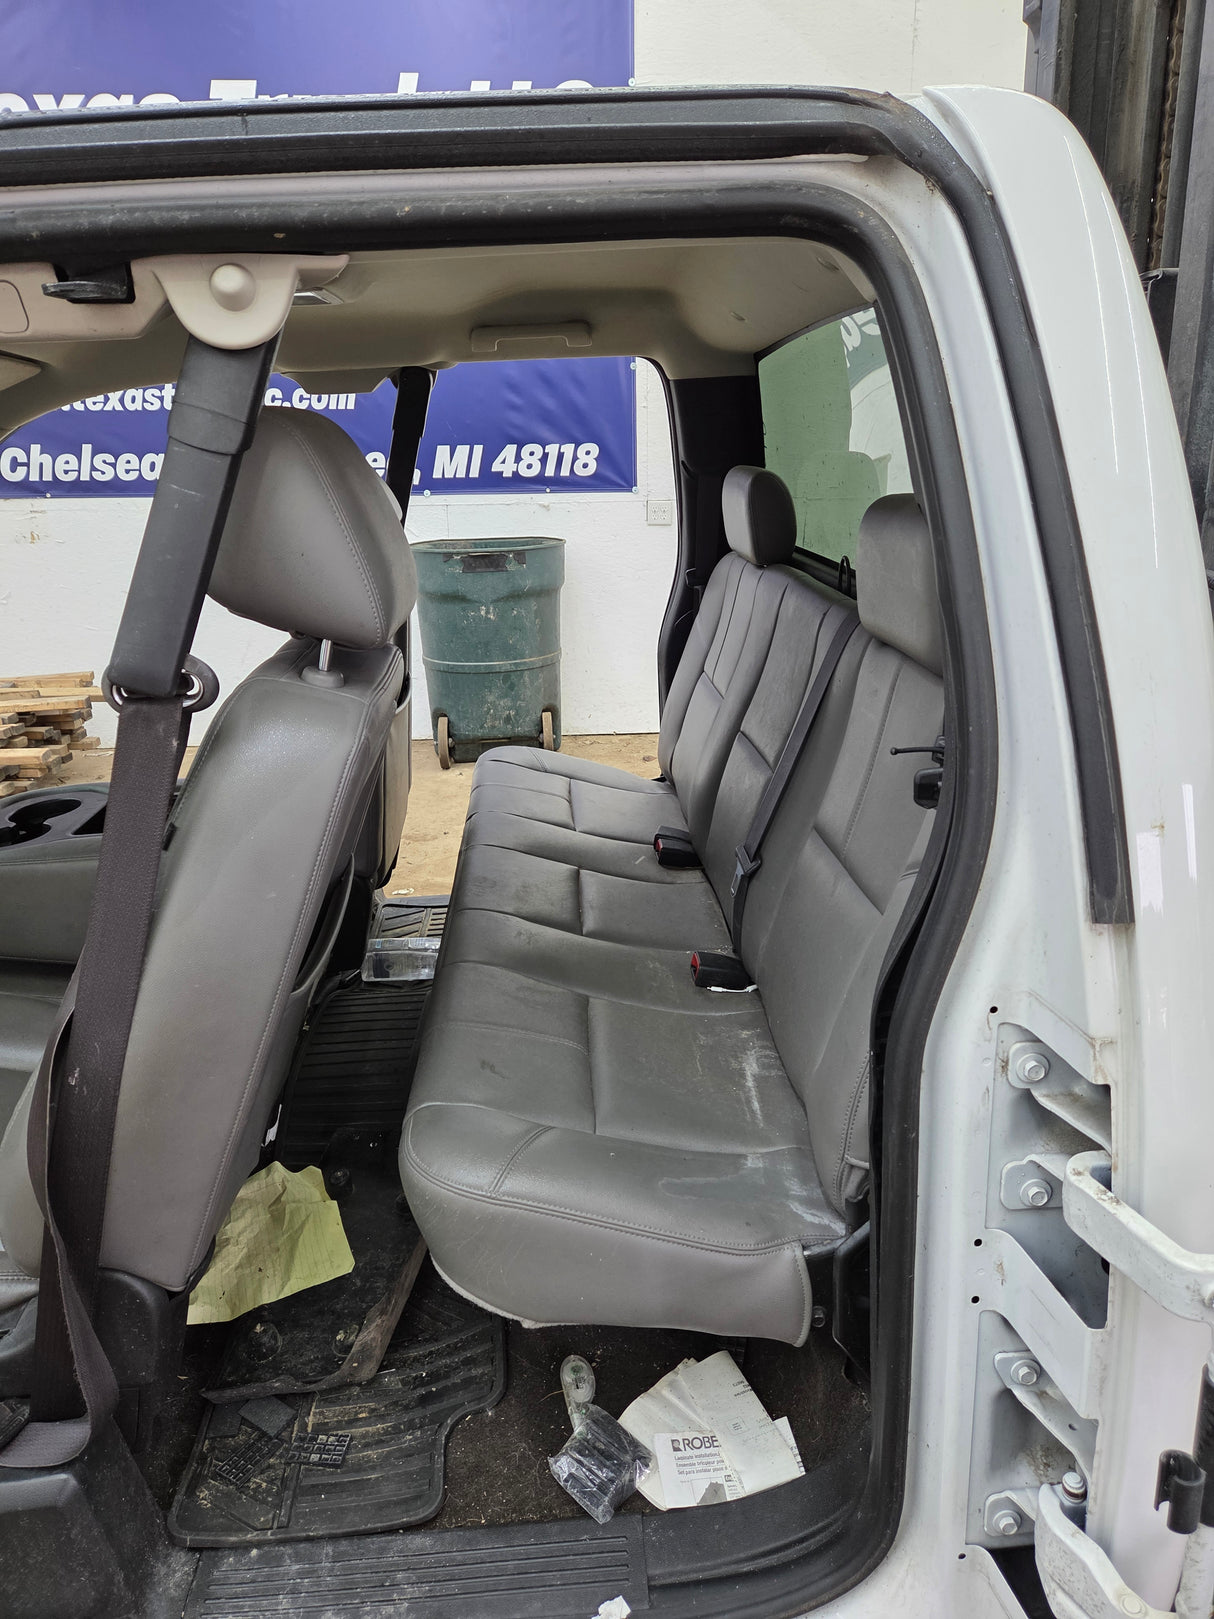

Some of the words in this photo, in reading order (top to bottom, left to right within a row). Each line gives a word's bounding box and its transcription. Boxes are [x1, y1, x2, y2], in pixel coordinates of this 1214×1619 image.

[0, 444, 165, 481] Chelsea
[433, 445, 483, 478] MI
[491, 443, 599, 477] 48118
[682, 1435, 722, 1451] ROBE
